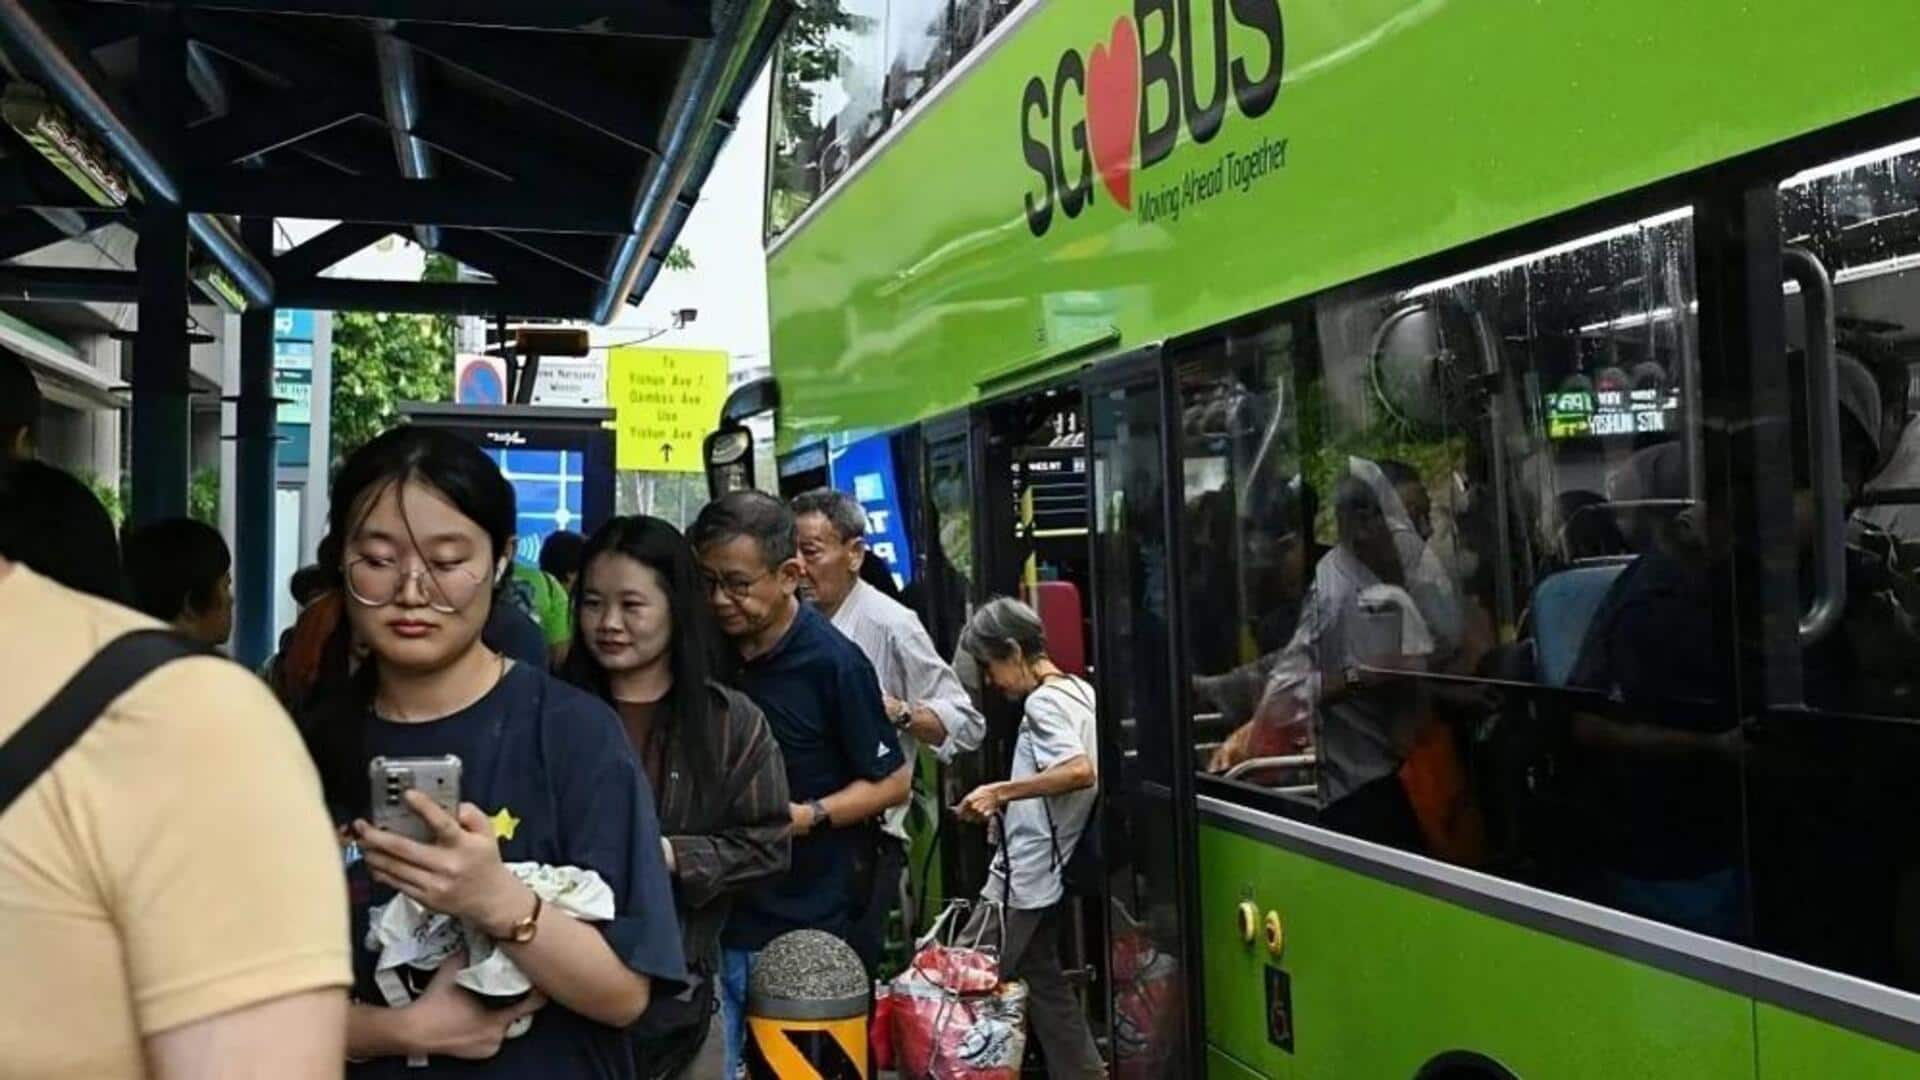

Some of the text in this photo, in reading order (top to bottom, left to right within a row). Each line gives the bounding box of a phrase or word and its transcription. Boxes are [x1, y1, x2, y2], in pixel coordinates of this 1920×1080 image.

[1137, 136, 1289, 225] Moving Ahead Together
[662, 354, 676, 368] To
[671, 374, 692, 387] Ave
[681, 391, 701, 405] Ave
[656, 410, 678, 422] Use
[672, 426, 692, 440] Ave
